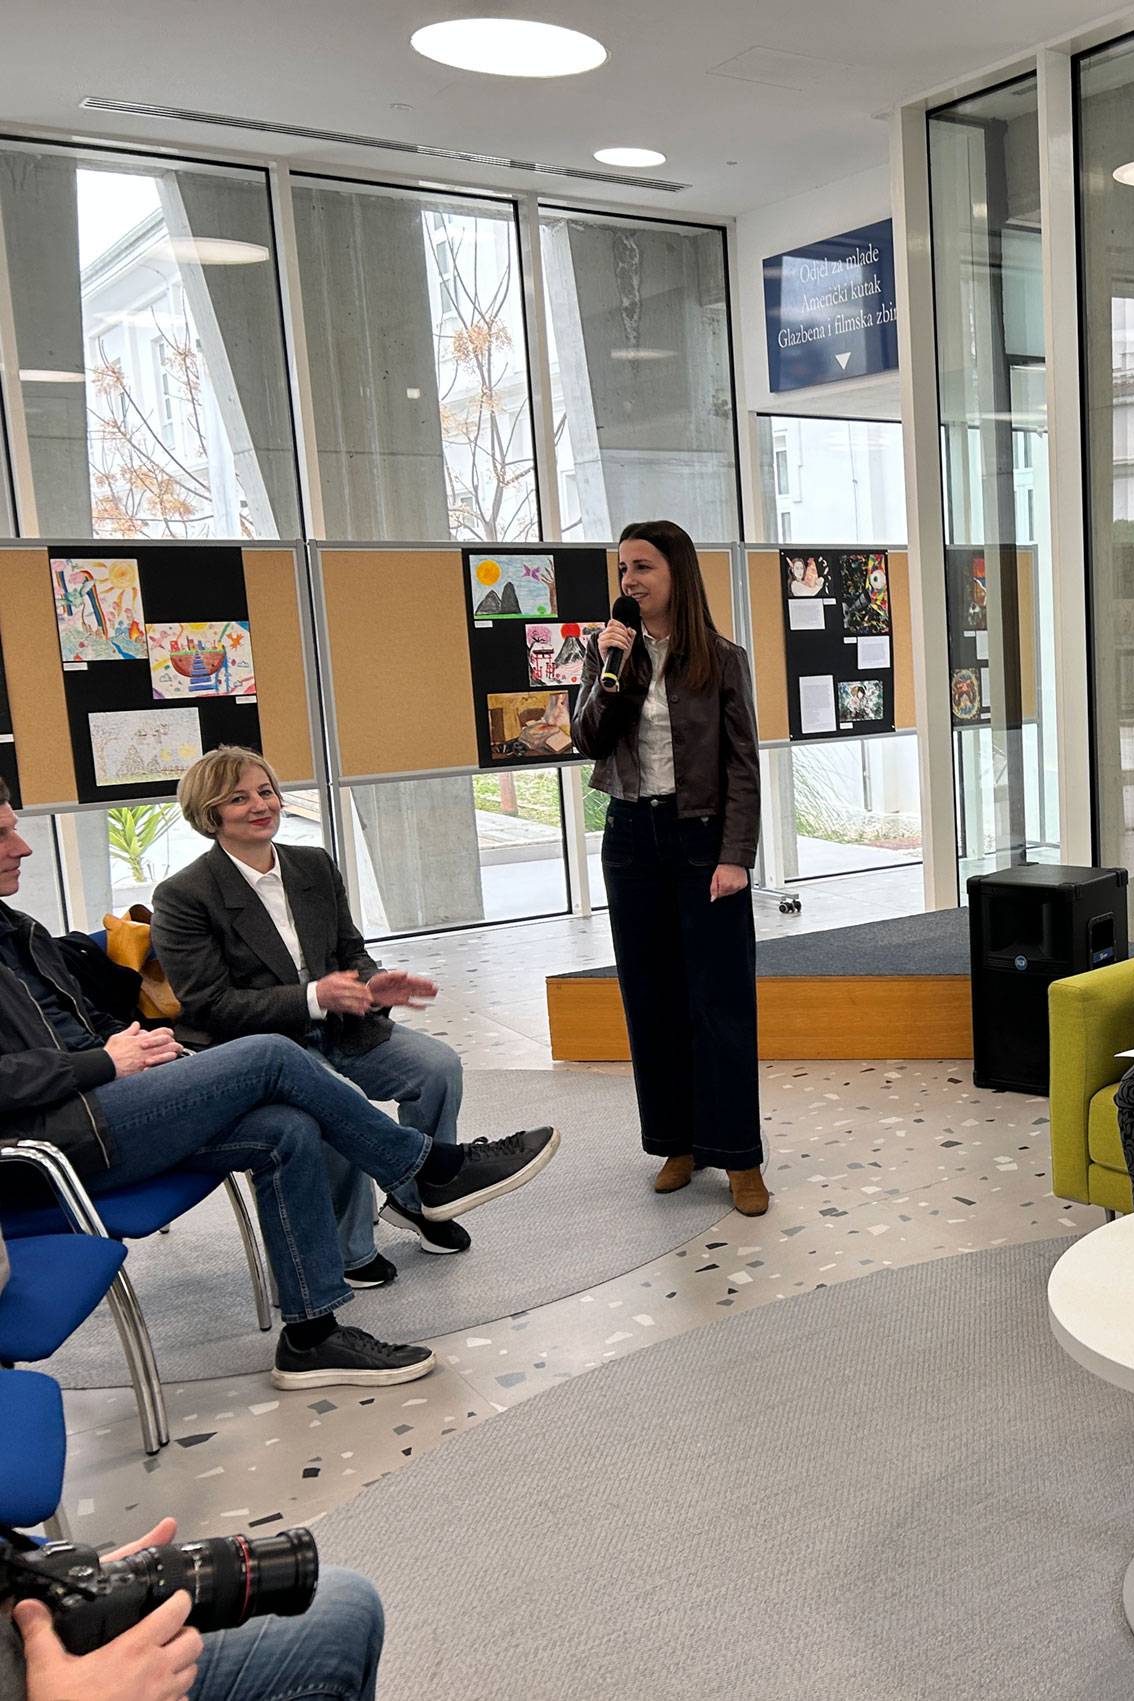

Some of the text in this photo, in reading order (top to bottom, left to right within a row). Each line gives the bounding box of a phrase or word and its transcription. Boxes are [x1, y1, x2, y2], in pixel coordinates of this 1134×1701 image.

[800, 243, 880, 283] Odjel za mlade
[801, 273, 882, 313] Američki kutak
[778, 324, 825, 349] Glazbena
[828, 317, 832, 337] i
[835, 309, 873, 335] filmska
